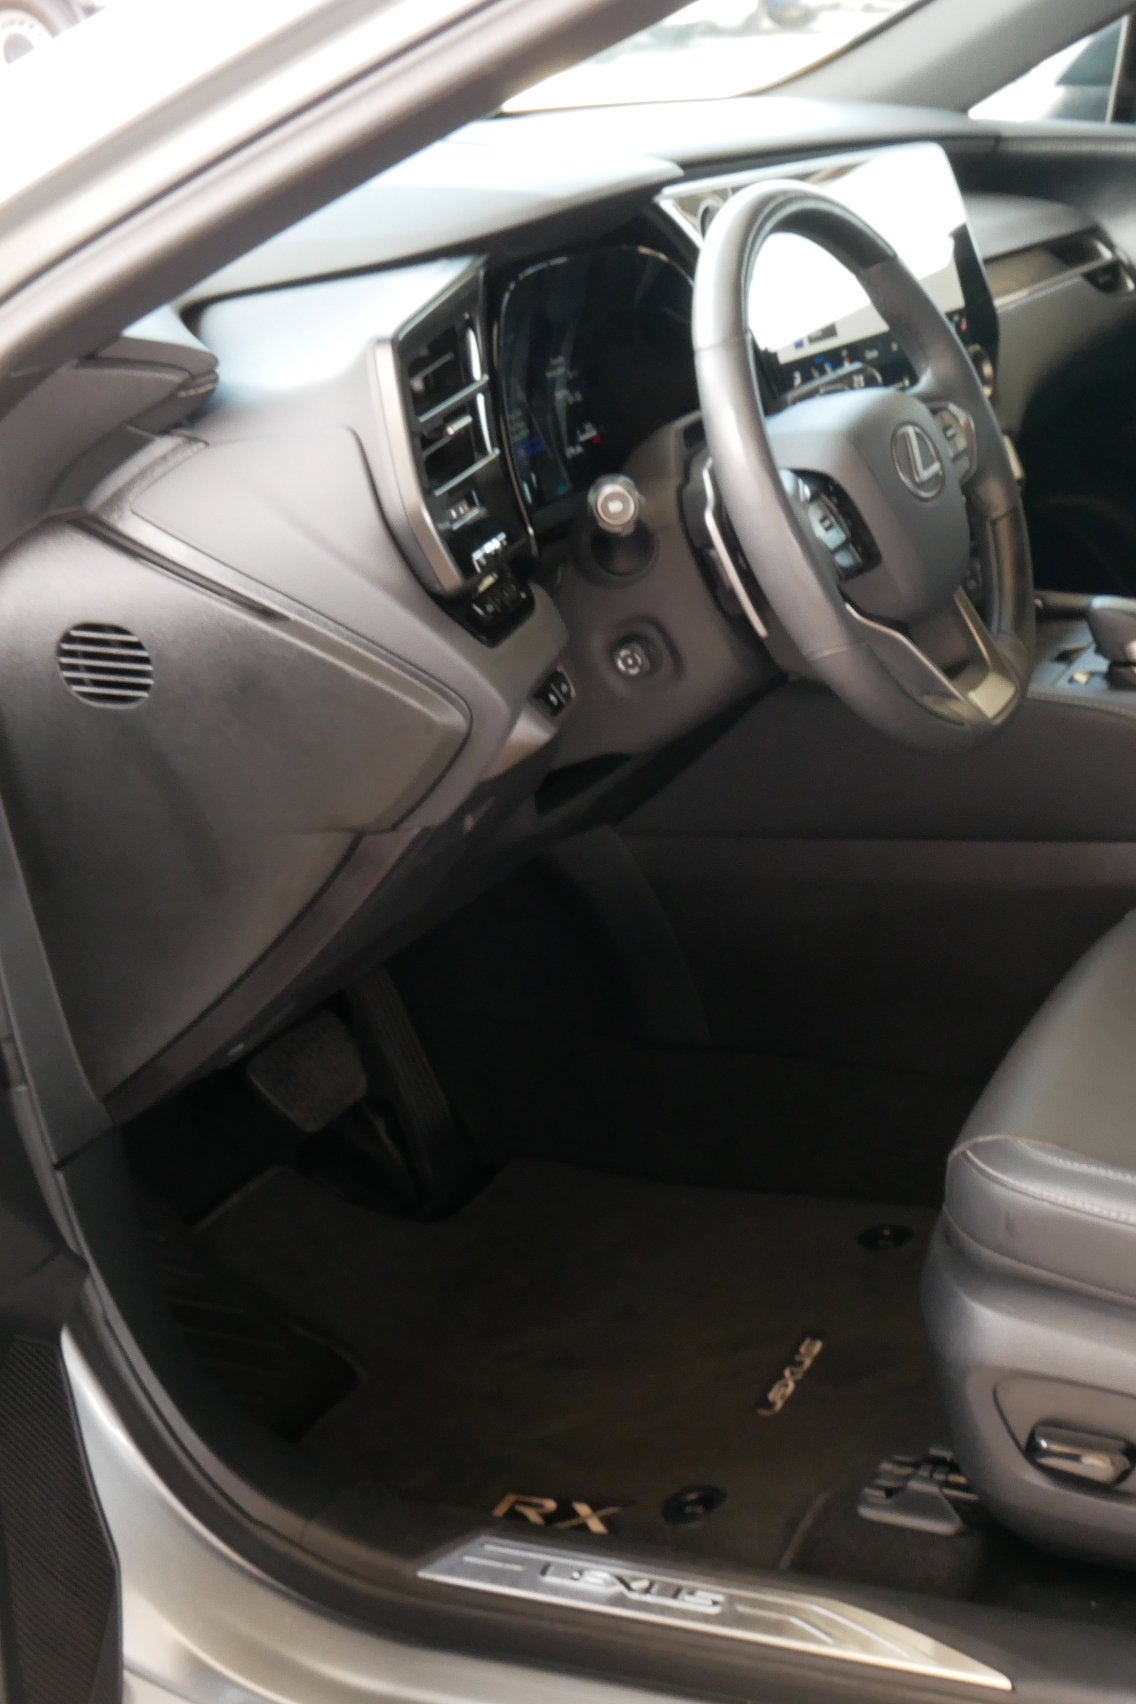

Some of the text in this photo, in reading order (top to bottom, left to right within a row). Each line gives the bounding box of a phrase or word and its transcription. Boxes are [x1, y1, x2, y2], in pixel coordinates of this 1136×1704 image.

[755, 1336, 824, 1416] LEXUS
[490, 1492, 621, 1536] RX
[538, 1562, 725, 1615] LEXUS
